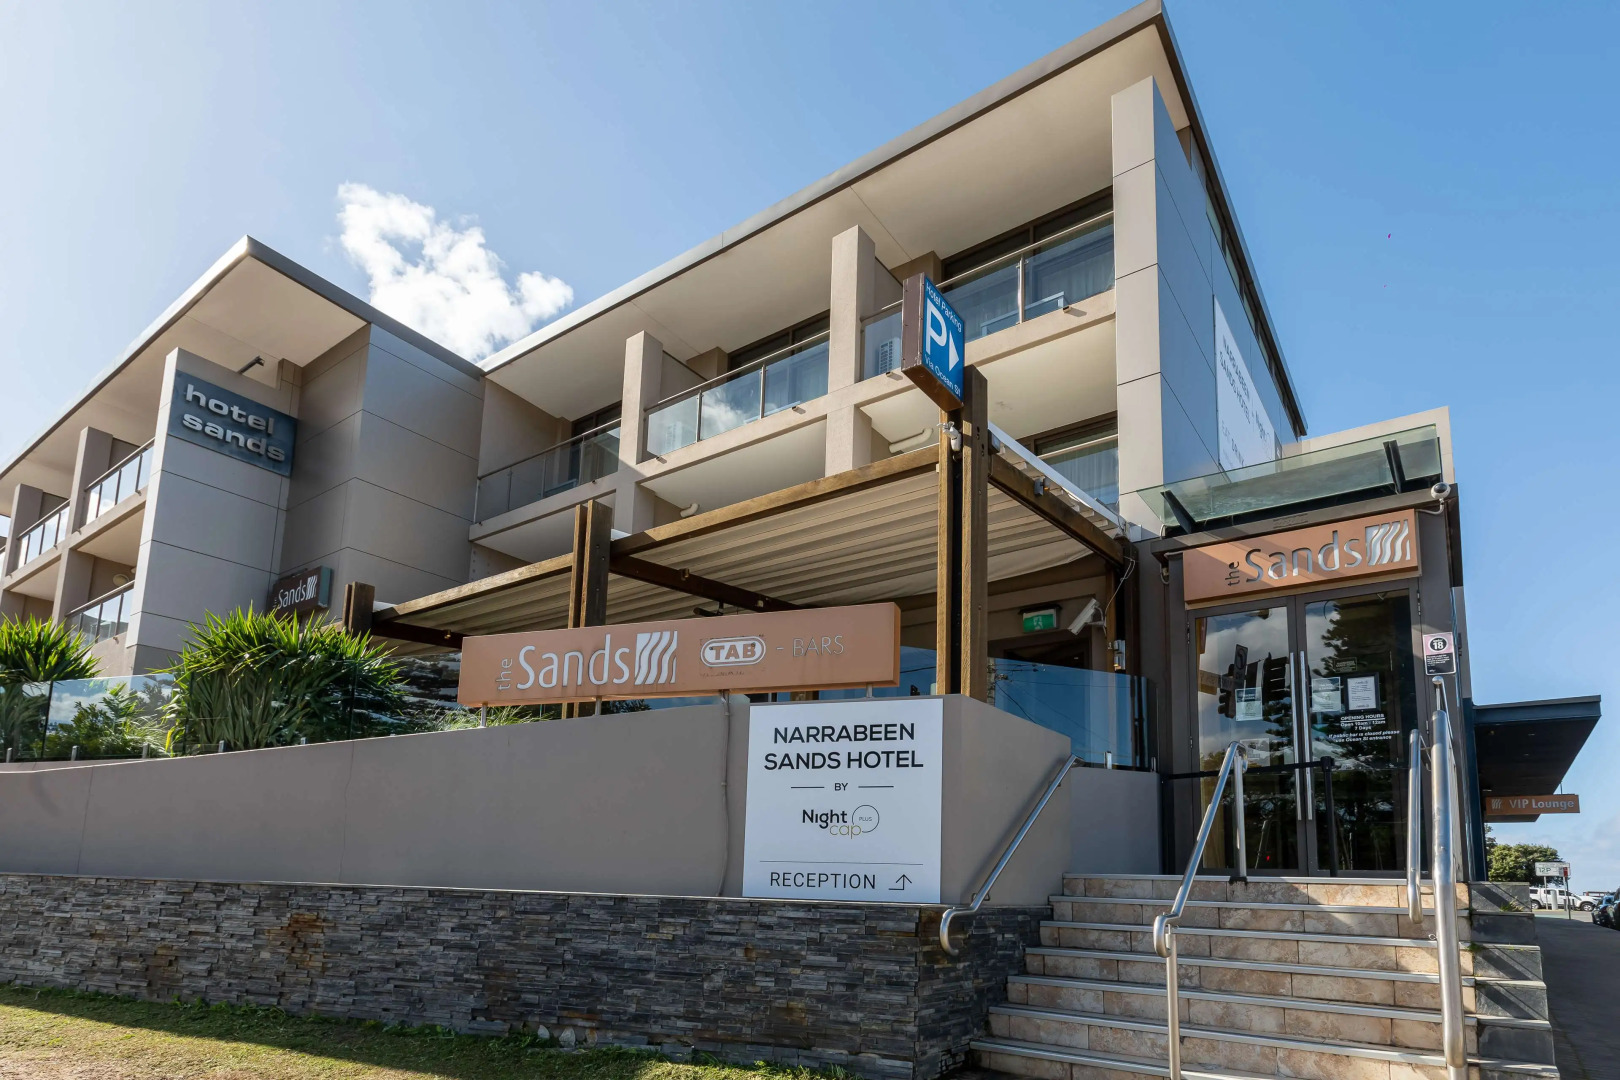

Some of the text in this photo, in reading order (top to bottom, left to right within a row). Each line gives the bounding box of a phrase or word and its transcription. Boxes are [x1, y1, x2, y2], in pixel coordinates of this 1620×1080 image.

[926, 282, 962, 333] Hotel Parking
[925, 297, 947, 356] P
[925, 354, 961, 397] Via Ocean St
[185, 383, 275, 435] hotel
[182, 413, 286, 462] sands
[1224, 530, 1363, 587] the Sands
[277, 579, 307, 610] Sands
[1432, 641, 1444, 650] 18
[495, 657, 513, 691] the
[516, 633, 631, 690] Sands
[711, 643, 757, 661] TAB
[793, 635, 844, 657] BARS
[773, 722, 915, 744] NARRABEEN
[763, 750, 924, 770] SANDS HOTEL
[834, 782, 849, 791] BY
[1509, 799, 1575, 810] VIP Lounge
[802, 808, 848, 829] Night
[829, 824, 862, 840] cap
[770, 871, 876, 890] RECEPTION
